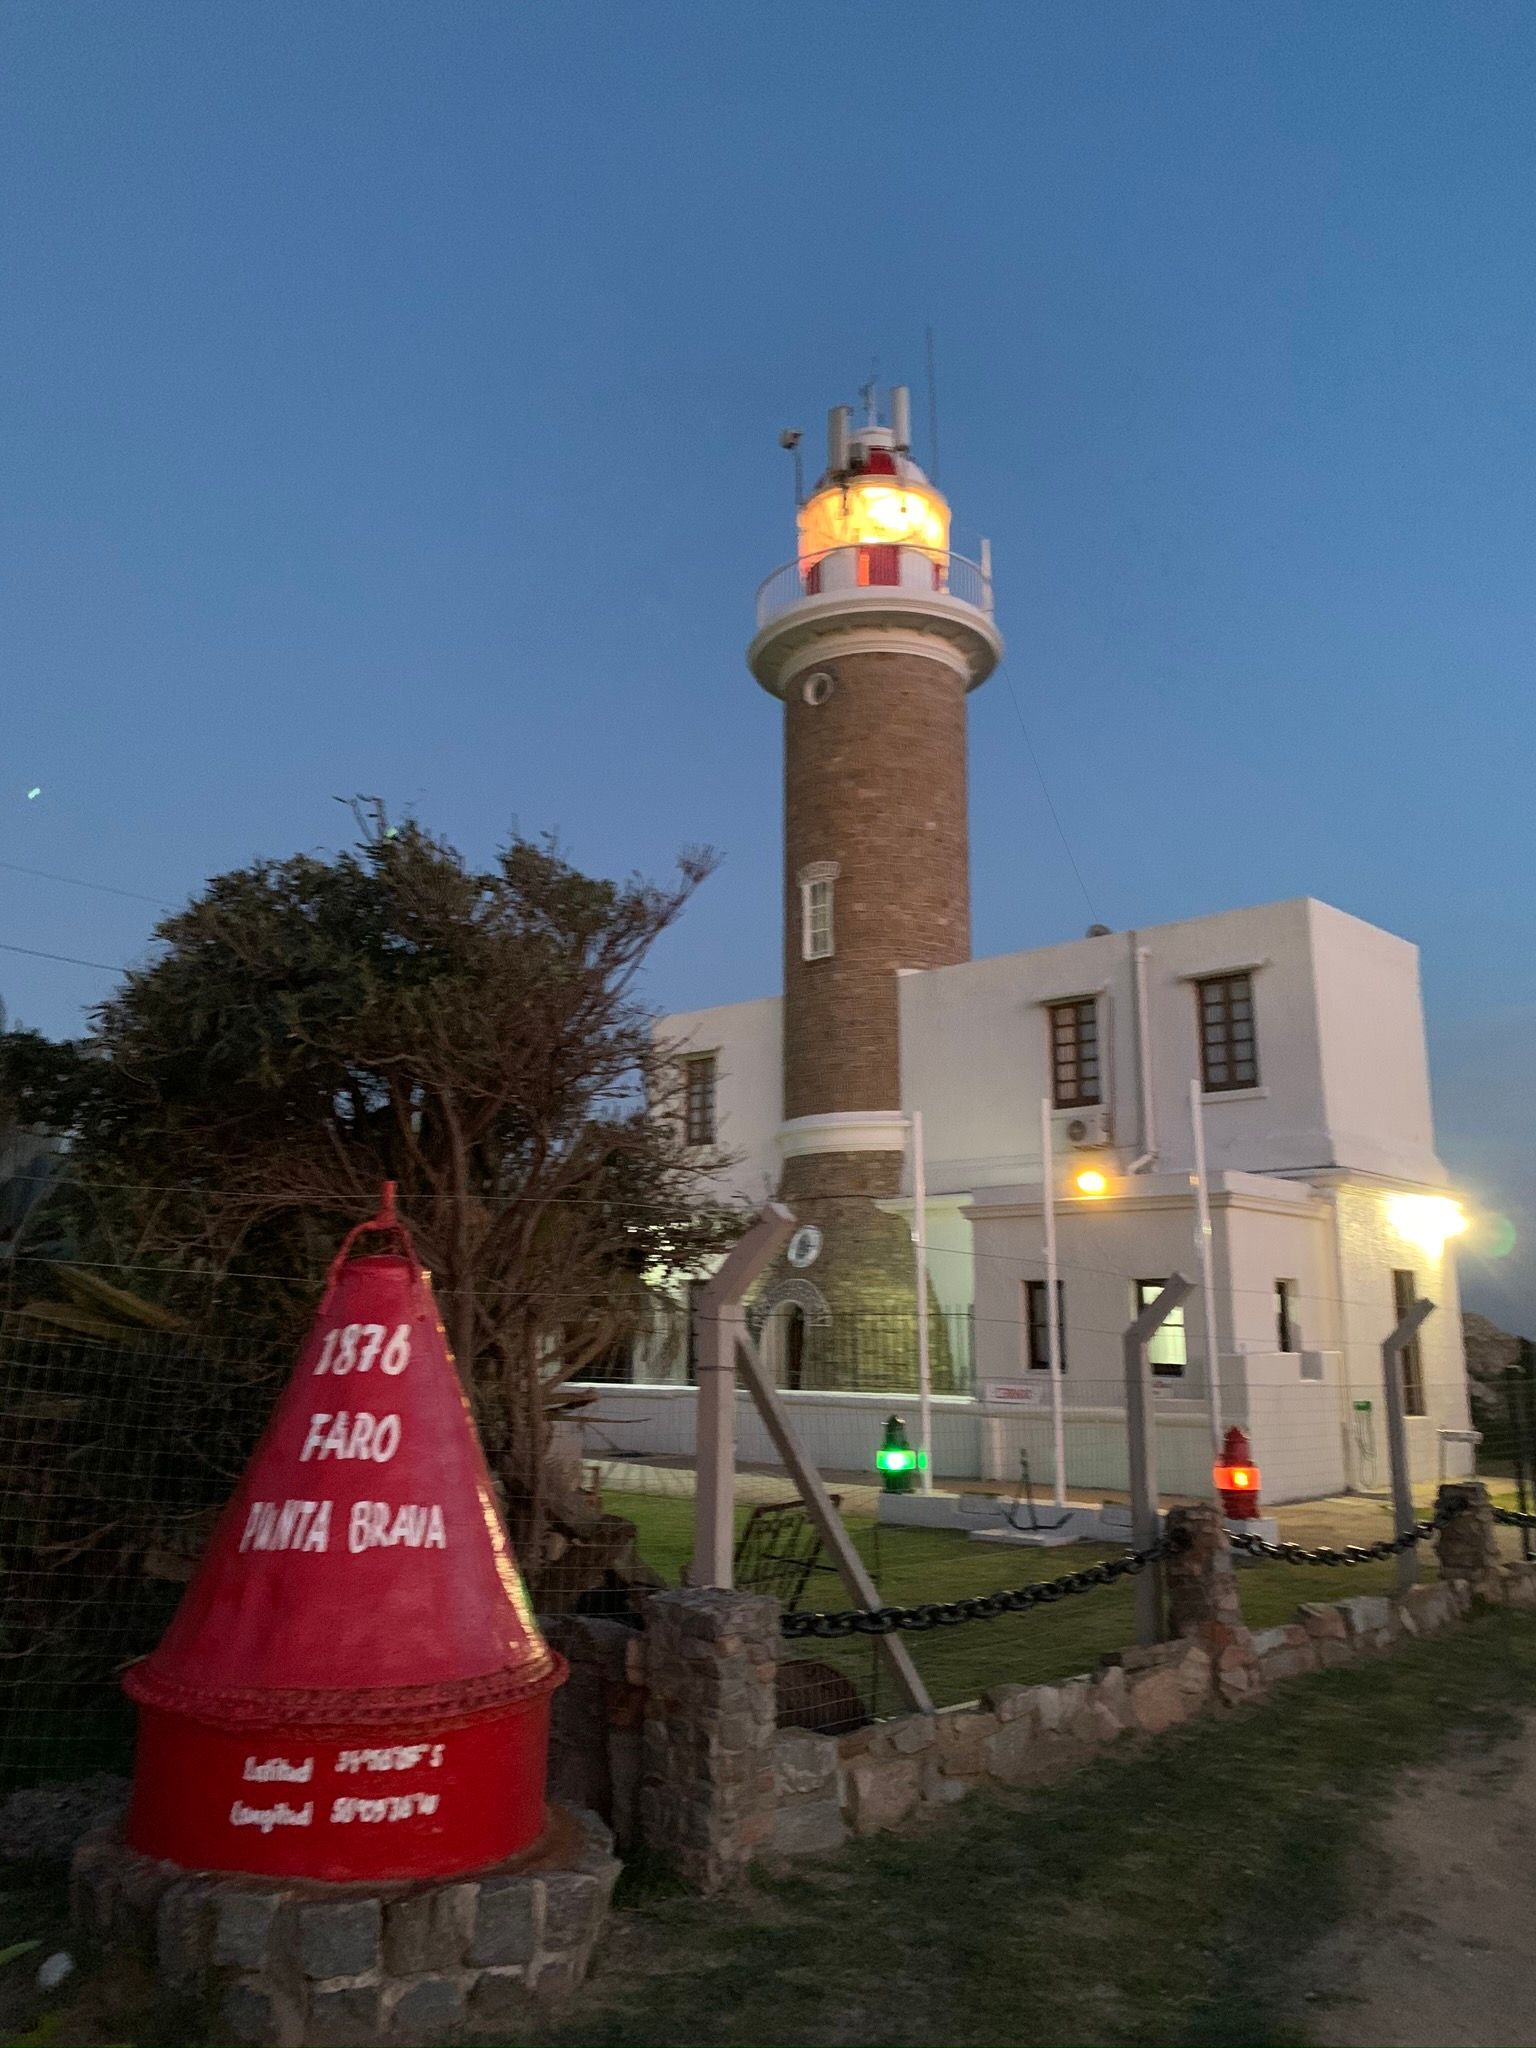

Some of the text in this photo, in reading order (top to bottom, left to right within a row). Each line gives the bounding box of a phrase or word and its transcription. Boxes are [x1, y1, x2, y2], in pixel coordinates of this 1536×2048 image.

[312, 1323, 412, 1376] 1876
[299, 1410, 402, 1463] FARO
[239, 1499, 447, 1554] PUNTA BRAVA
